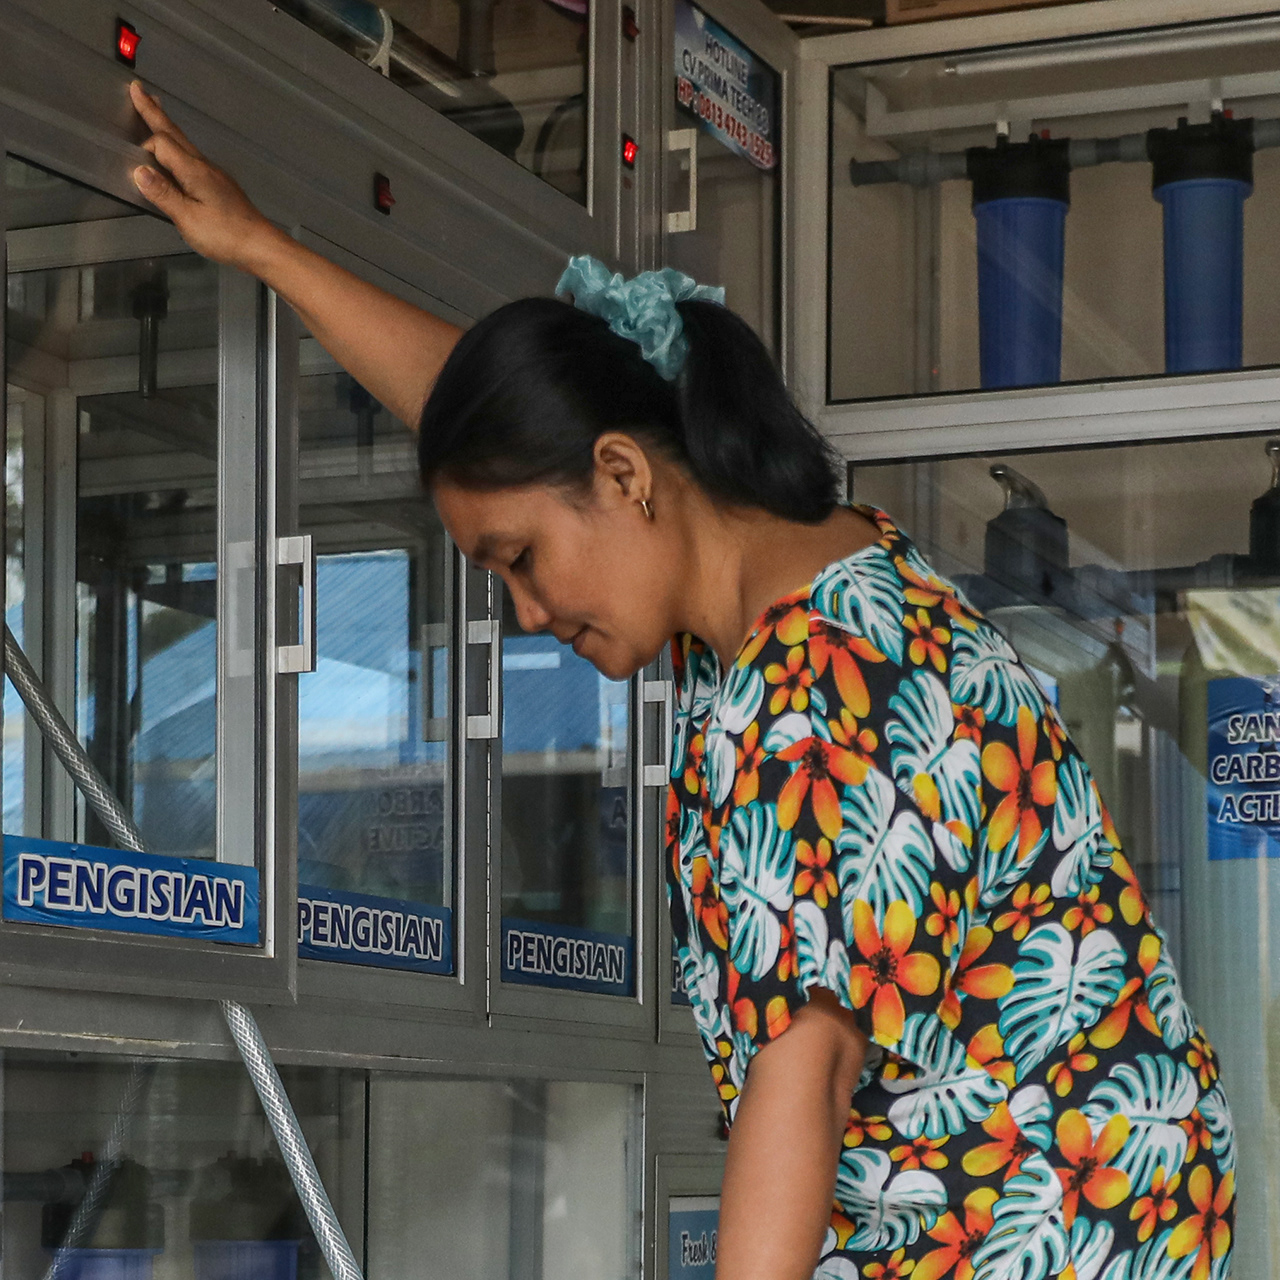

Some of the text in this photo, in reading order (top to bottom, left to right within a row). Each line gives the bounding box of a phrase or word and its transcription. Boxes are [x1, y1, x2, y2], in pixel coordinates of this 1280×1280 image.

[705, 32, 748, 86] HOTLINE
[18, 853, 245, 928] PENGISIAN
[298, 898, 442, 962] PENGISIAN
[507, 930, 624, 983] PENGISIAN
[681, 1231, 709, 1267] Fresh
